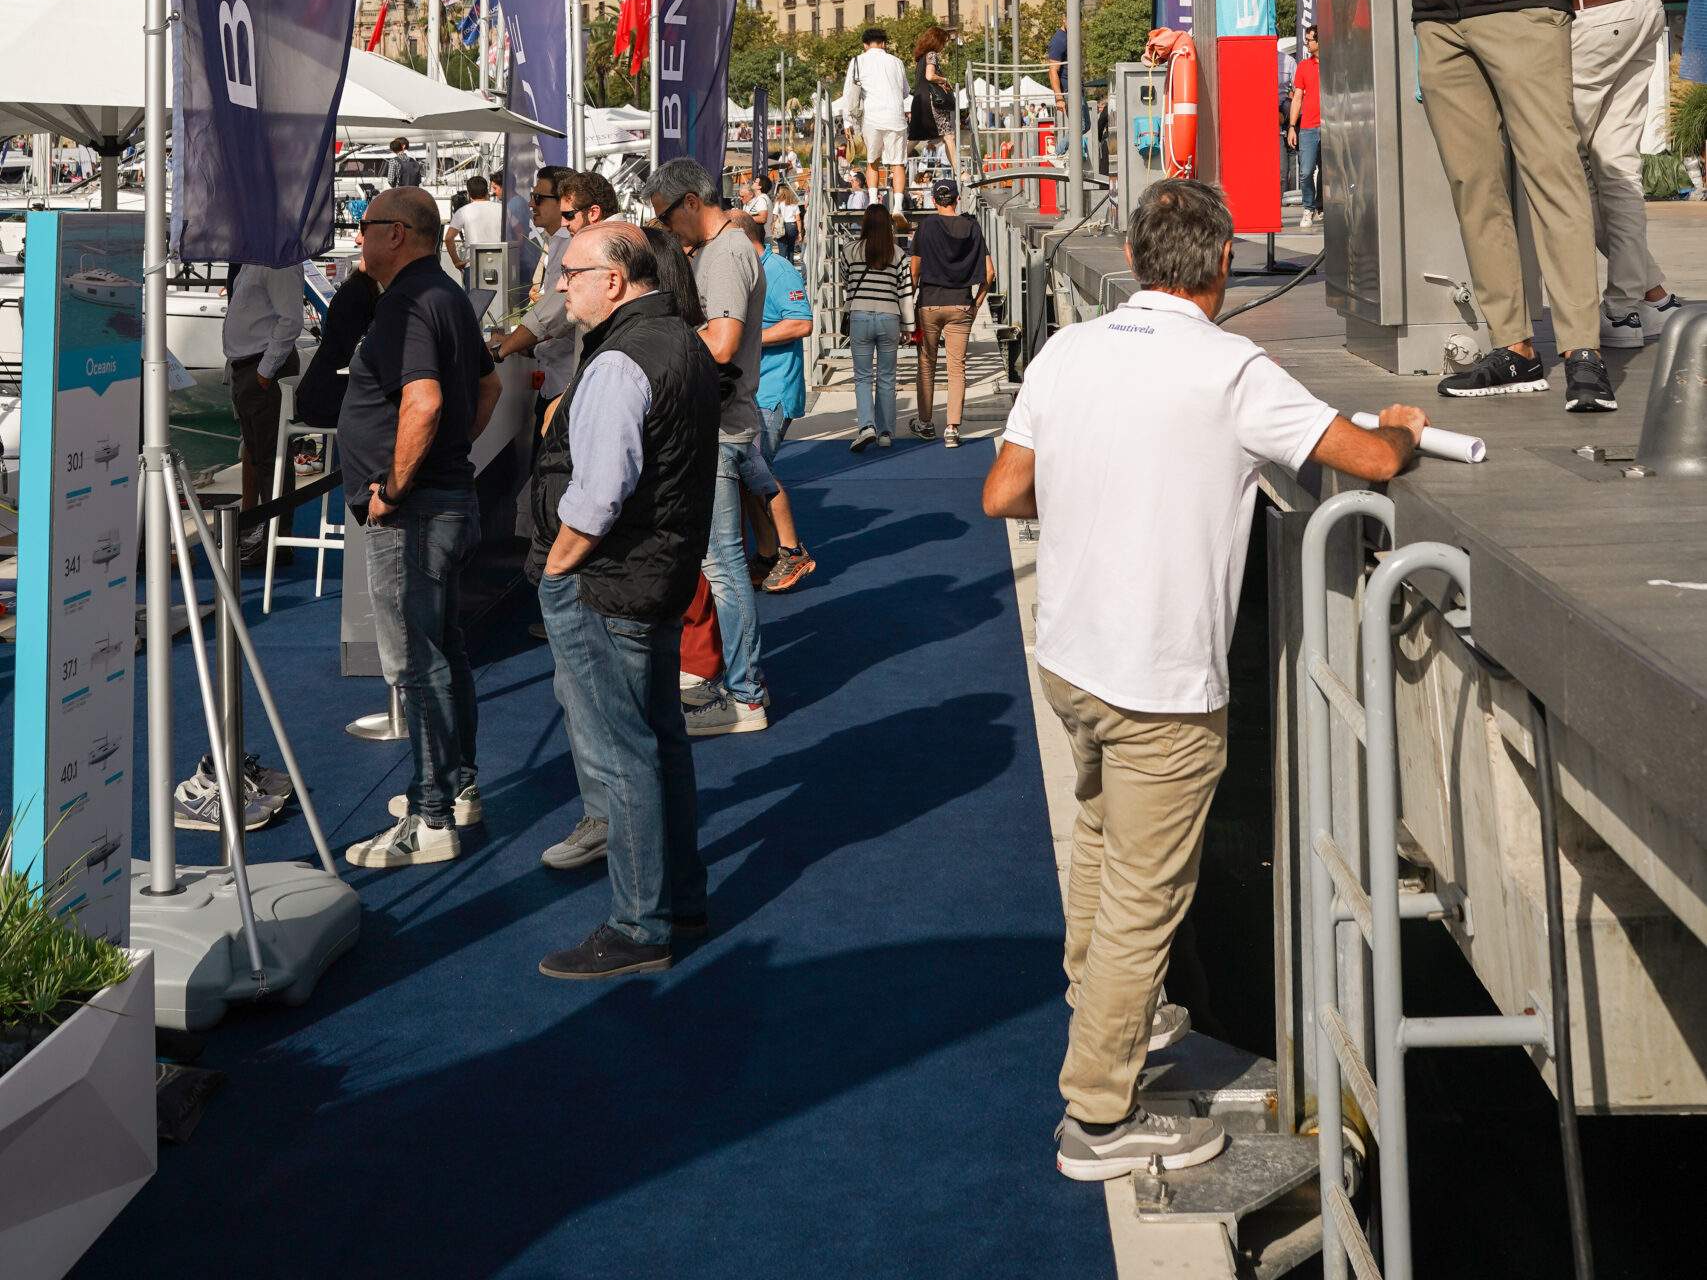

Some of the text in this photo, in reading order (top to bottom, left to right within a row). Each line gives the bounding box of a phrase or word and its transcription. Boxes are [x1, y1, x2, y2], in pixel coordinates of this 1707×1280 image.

[85, 355, 117, 376] Oceanis
[67, 451, 84, 473] 30.1
[64, 554, 82, 578] 34.1
[62, 656, 79, 681] 37.1
[60, 760, 78, 784] 40.1
